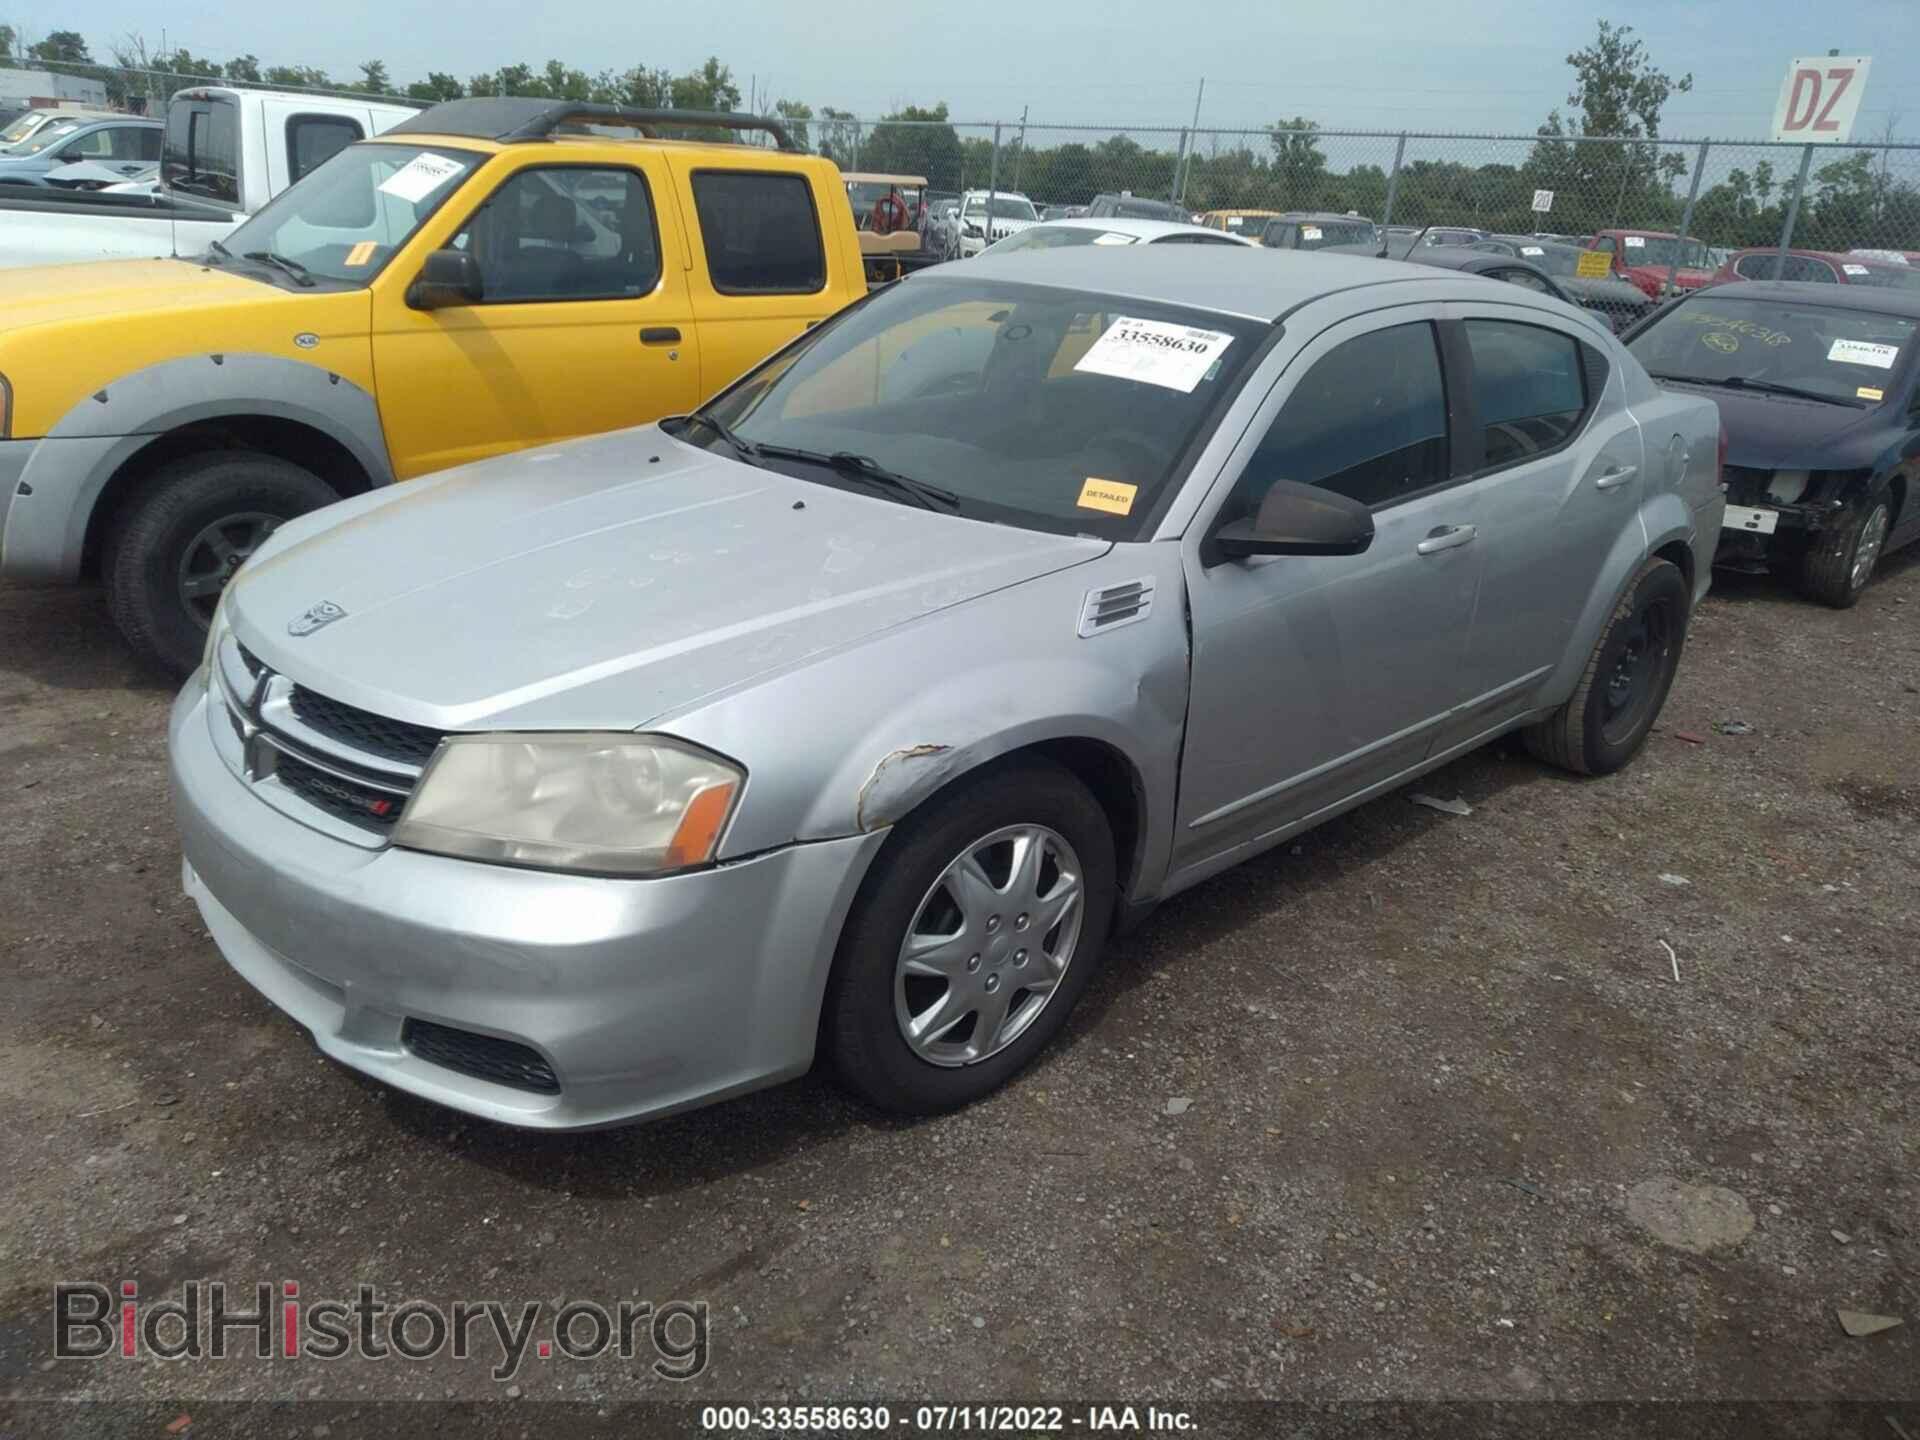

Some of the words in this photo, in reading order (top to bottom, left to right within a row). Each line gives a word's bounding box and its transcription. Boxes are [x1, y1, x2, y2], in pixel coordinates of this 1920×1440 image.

[1783, 68, 1856, 131] DZ
[1113, 328, 1208, 354] 33558630
[1086, 489, 1128, 503] DETAILED
